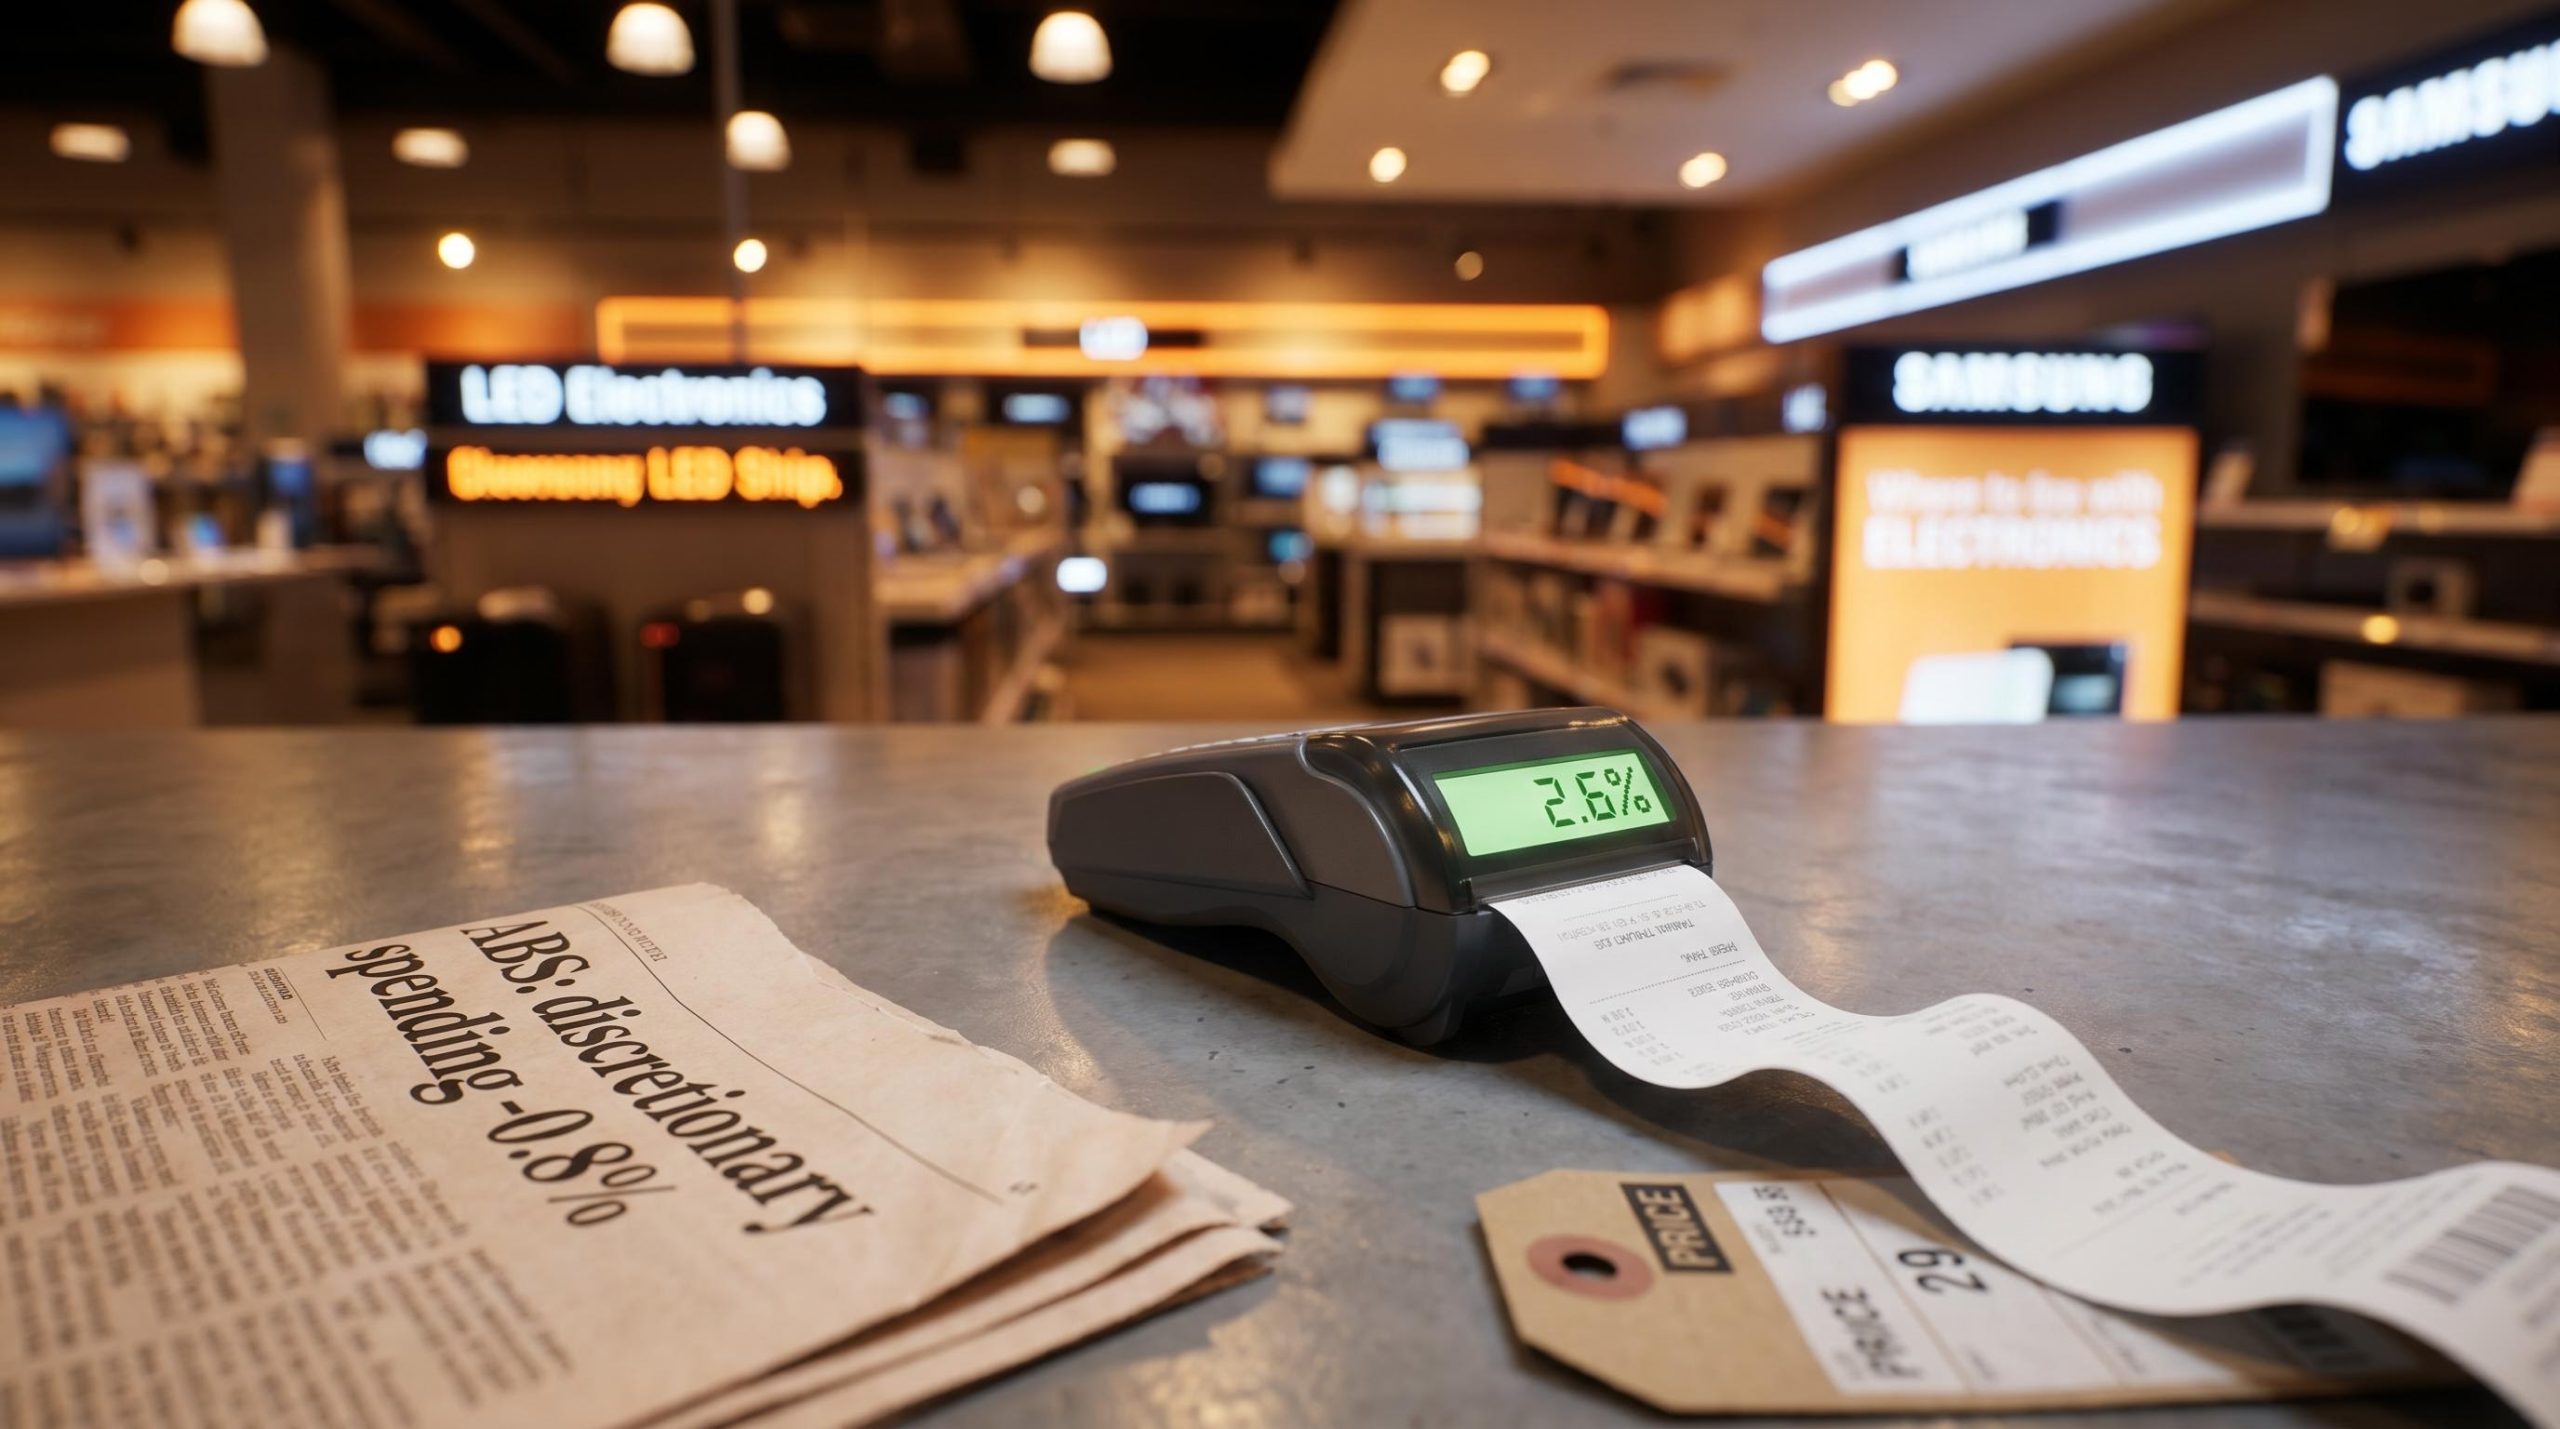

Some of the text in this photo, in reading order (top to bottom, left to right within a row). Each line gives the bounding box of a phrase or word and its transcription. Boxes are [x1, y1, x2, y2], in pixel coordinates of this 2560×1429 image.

[460, 365, 827, 426] LED Electronics
[1893, 351, 2153, 412] SAMSUNG
[1863, 515, 2161, 570] ELECTRONICS
[1533, 767, 1652, 828] 2.6%
[325, 944, 525, 1106] spending
[487, 1100, 677, 1227] -0.8%
[461, 920, 592, 994] ABS:
[532, 996, 875, 1234] discretionary
[1635, 1189, 1718, 1267] PRICE
[1897, 1249, 1989, 1293] 29
[1821, 1285, 1923, 1379] PRICE
